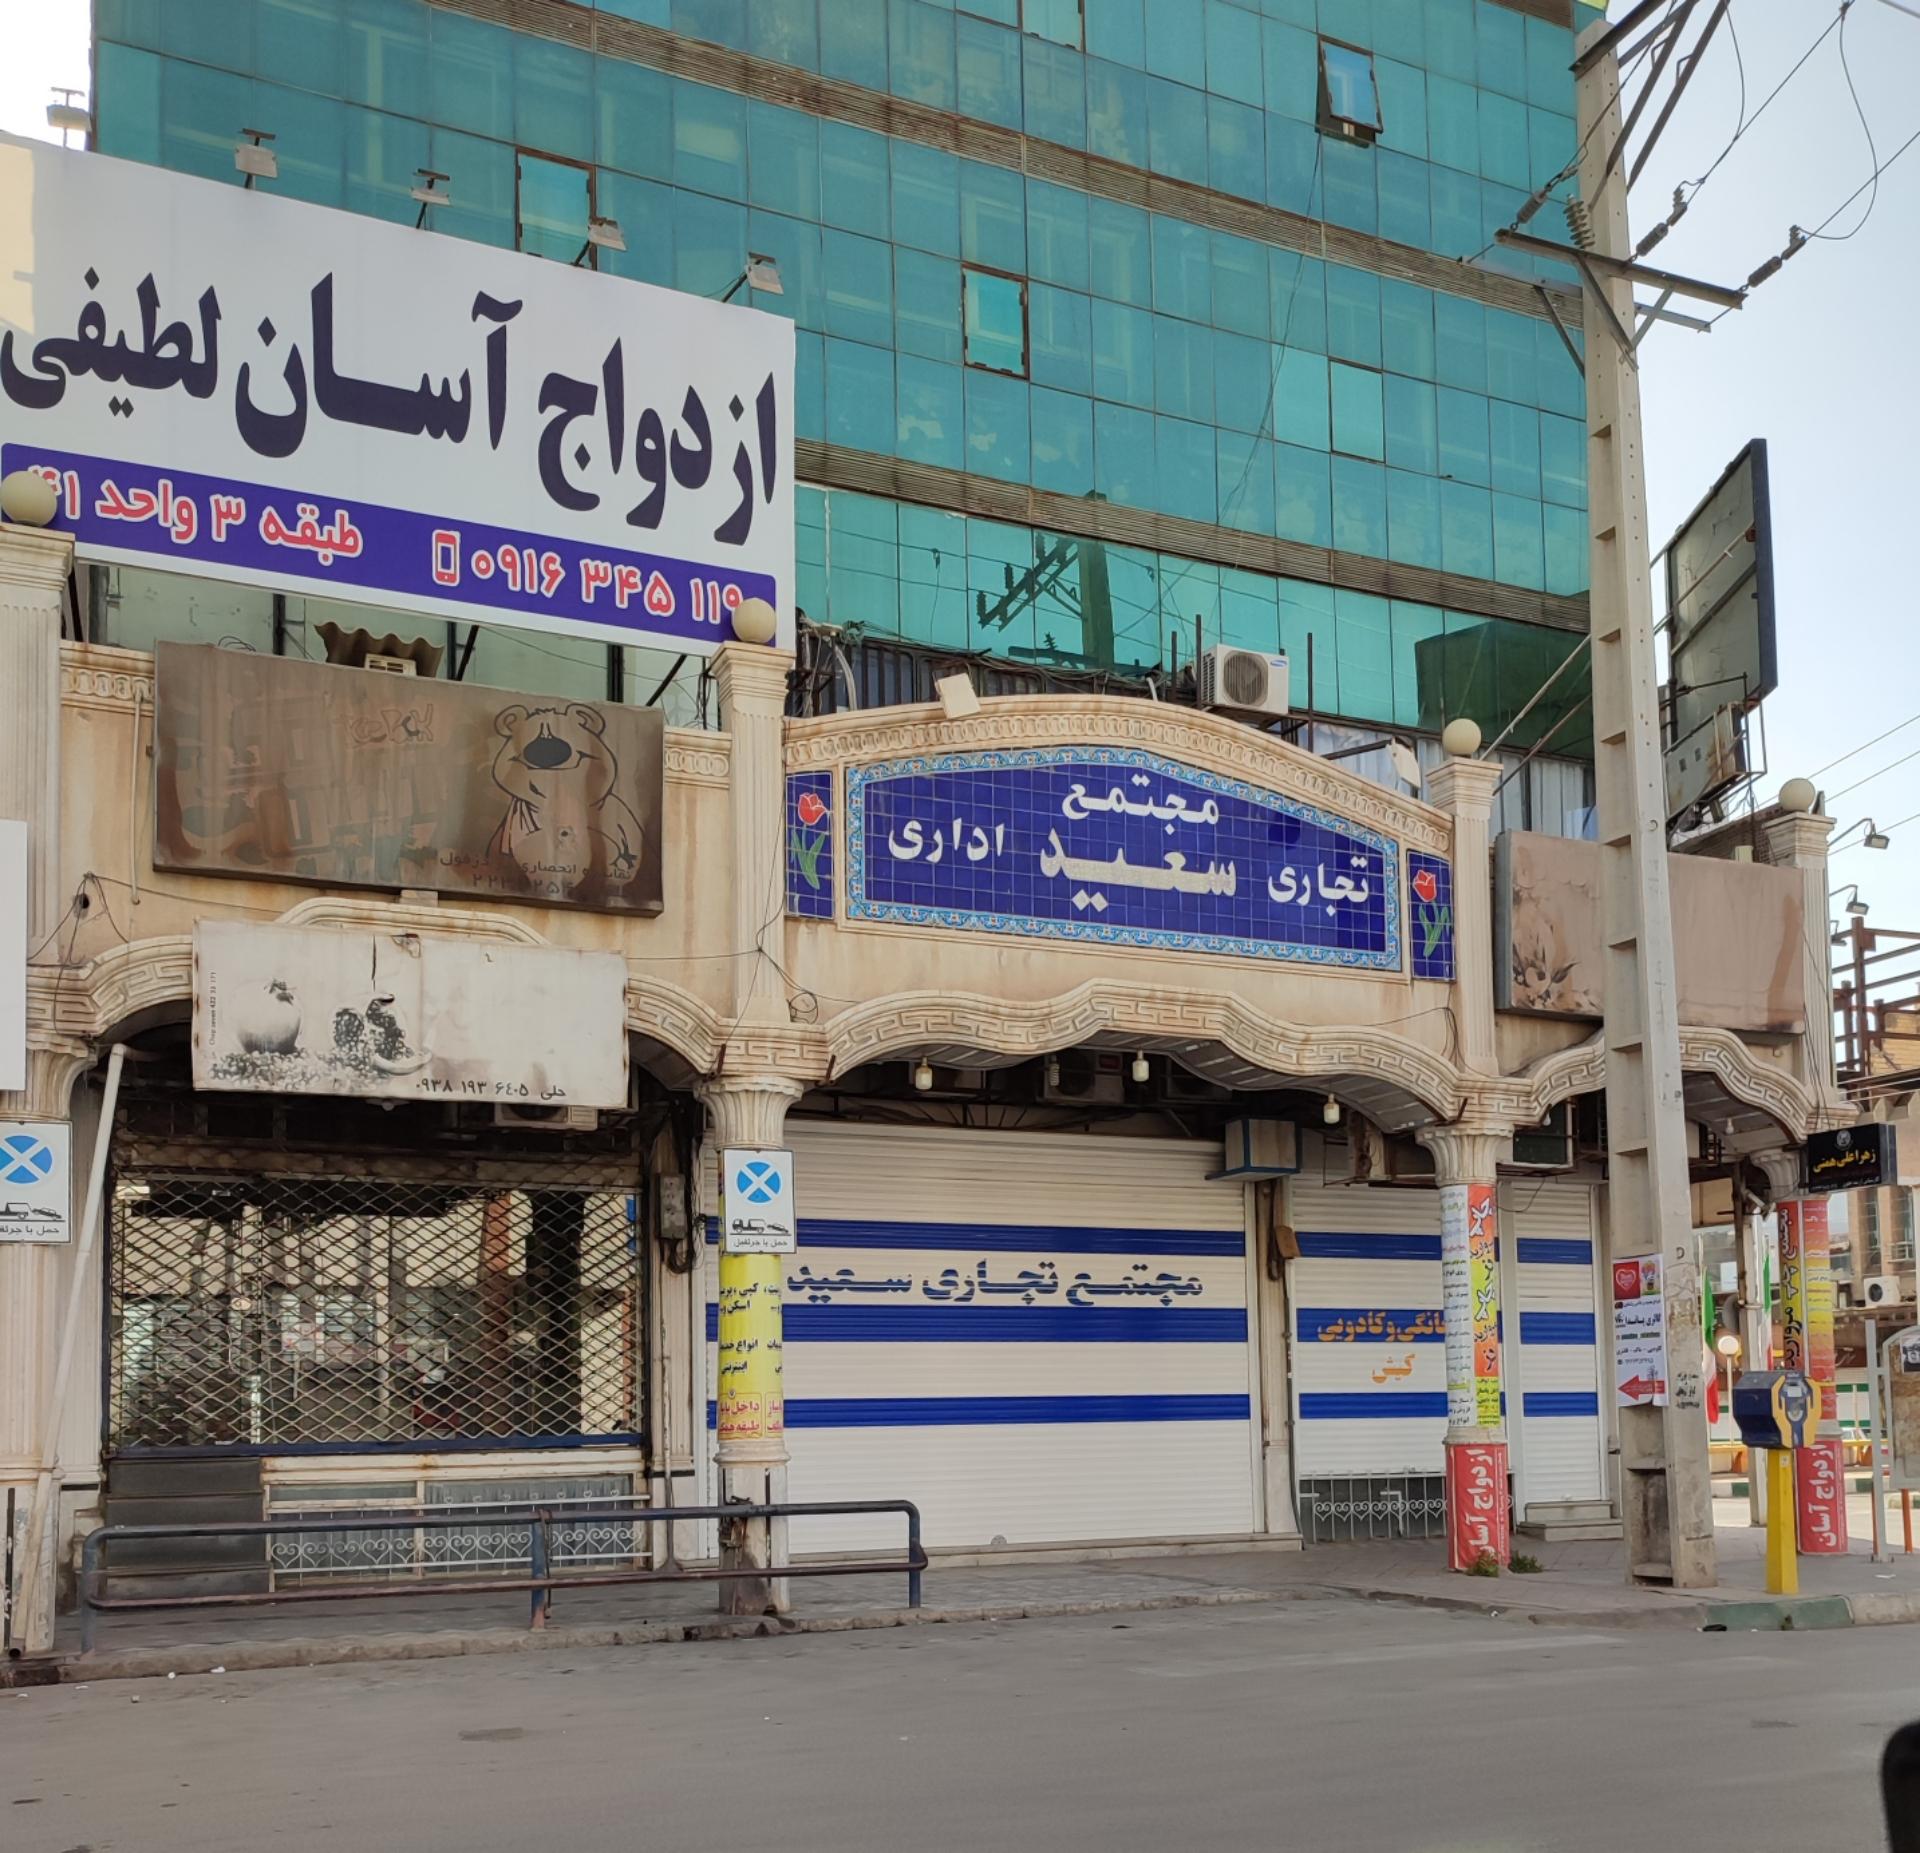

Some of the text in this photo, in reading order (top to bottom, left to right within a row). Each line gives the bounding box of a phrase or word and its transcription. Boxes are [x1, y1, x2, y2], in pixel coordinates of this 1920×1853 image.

[0, 266, 777, 546] ازدواج آسان لطیفی
[94, 479, 196, 543] واحد
[210, 494, 247, 542] ۳
[258, 509, 363, 566] طبقه
[471, 544, 744, 625] ۰۹۱۶ ۳۴۵ ۱۱۹
[1061, 774, 1221, 838] مجتمع
[888, 816, 1371, 917] تجاری سعید اداری
[461, 1080, 487, 1095] ۱۹۳
[25, 1225, 33, 1235] با
[36, 1224, 60, 1237] حمل
[786, 1258, 1204, 1307] مجتمع تجاری سعید
[1396, 1311, 1447, 1341] انگی
[1465, 1448, 1494, 1510] ازدواج
[1809, 1444, 1835, 1500] ازدواج
[1807, 1502, 1838, 1547] آسان
